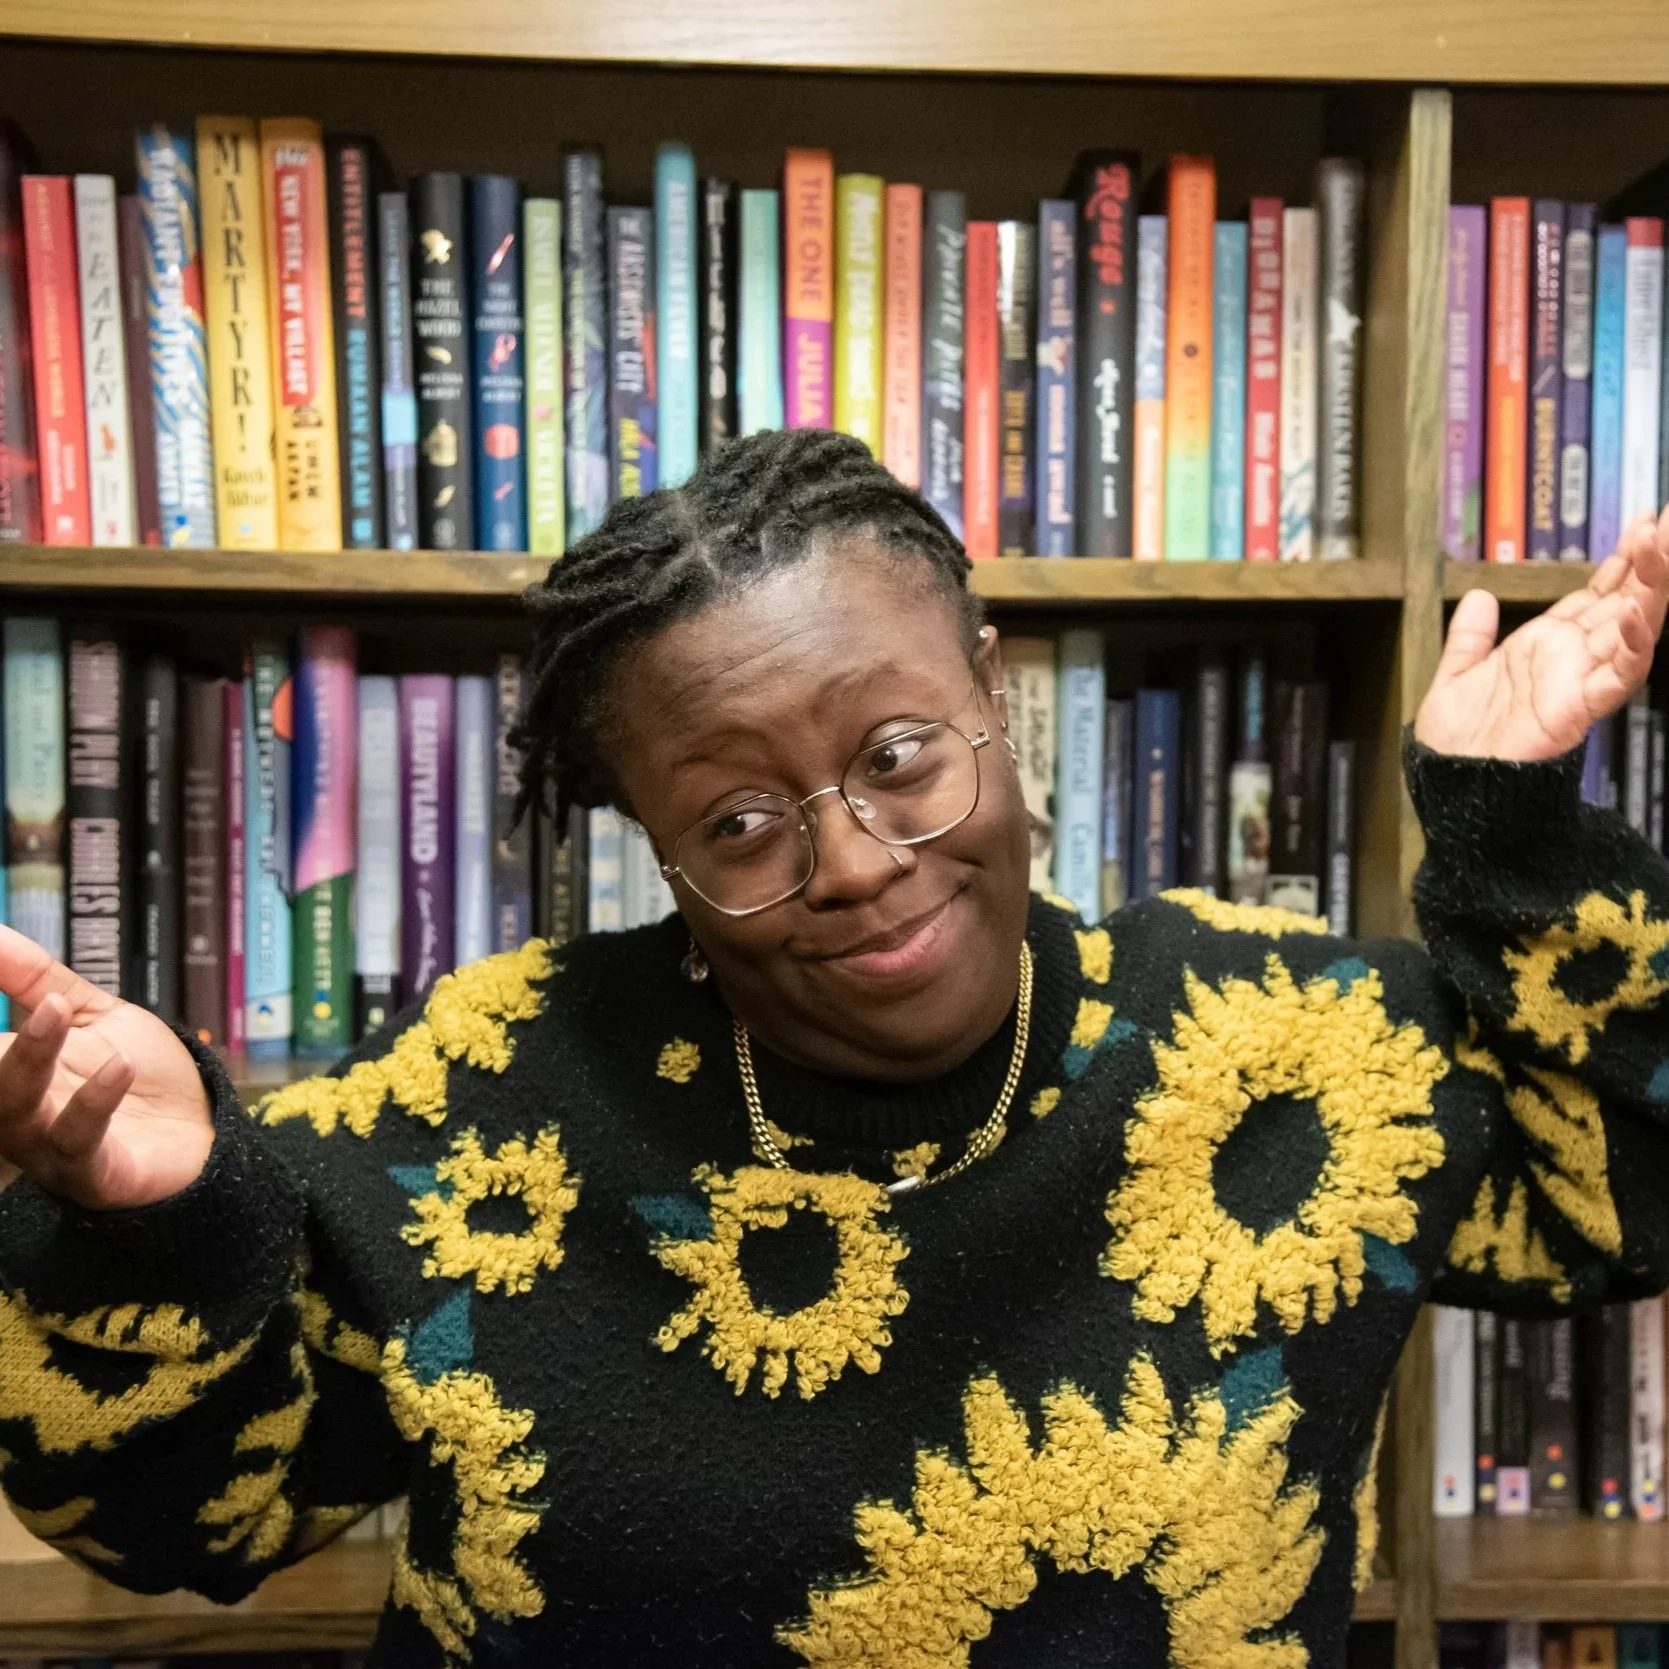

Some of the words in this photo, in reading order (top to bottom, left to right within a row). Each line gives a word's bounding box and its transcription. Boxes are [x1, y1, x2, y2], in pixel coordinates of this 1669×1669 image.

[341, 148, 367, 318] ENTITLEMENT
[799, 177, 822, 230] THE
[1085, 163, 1130, 286] Rouge
[213, 131, 256, 453] MARTYR!
[799, 240, 822, 302] ONE
[1049, 277, 1073, 329] well
[285, 318, 309, 396] VILLAGE
[347, 329, 370, 434] RUMAAN
[797, 333, 823, 425] JULIA
[350, 438, 373, 508] ALAM
[411, 698, 439, 865] BEAUTYLAND
